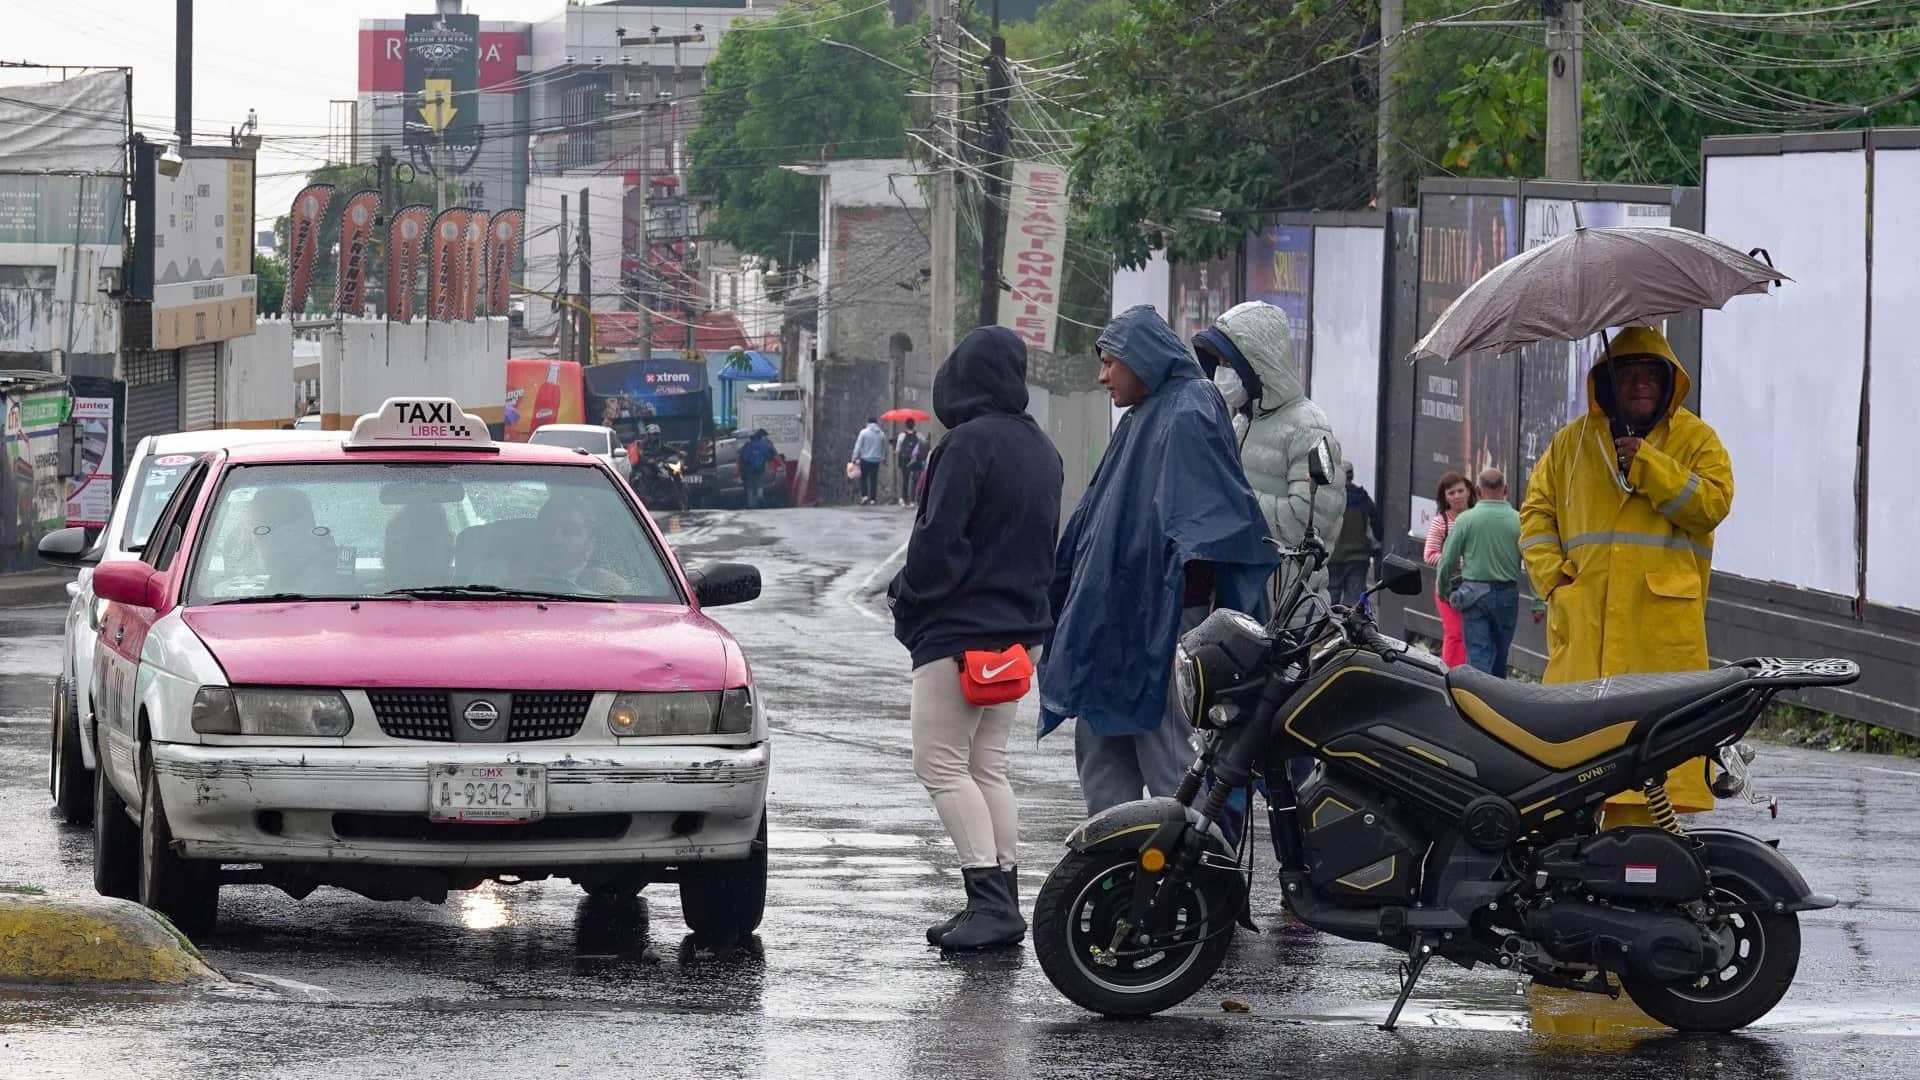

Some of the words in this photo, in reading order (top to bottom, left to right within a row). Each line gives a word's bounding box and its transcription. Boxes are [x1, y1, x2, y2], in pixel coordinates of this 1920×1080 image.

[1541, 203, 1560, 238] LOS
[1011, 171, 1059, 351] ESTACIONAMIEN
[1423, 226, 1435, 282] IL
[1438, 226, 1469, 284] DIVO
[340, 228, 365, 307] FRENOS
[655, 371, 691, 383] xtrem
[394, 402, 453, 424] TAXI
[411, 425, 448, 437] LIBRE
[466, 711, 498, 719] NISSAN
[471, 768, 503, 777] CDMX
[1577, 766, 1604, 783] OVNI
